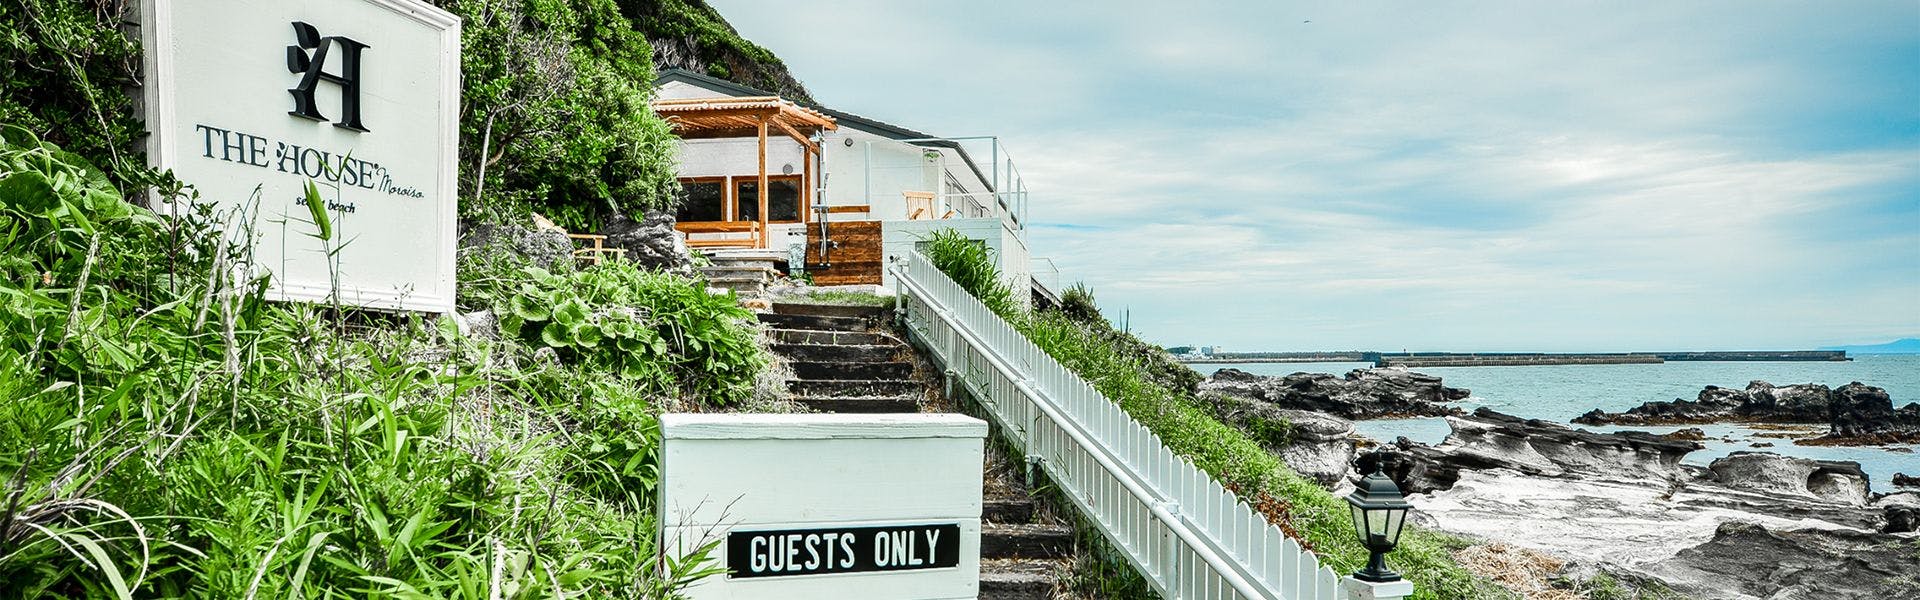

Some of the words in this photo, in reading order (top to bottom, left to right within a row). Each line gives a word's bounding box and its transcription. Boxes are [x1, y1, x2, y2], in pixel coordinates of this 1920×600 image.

[196, 124, 270, 168] THE
[276, 141, 376, 190] HOUSE
[327, 199, 356, 213] beach
[750, 533, 856, 573] GUESTS
[874, 528, 941, 568] ONLY
